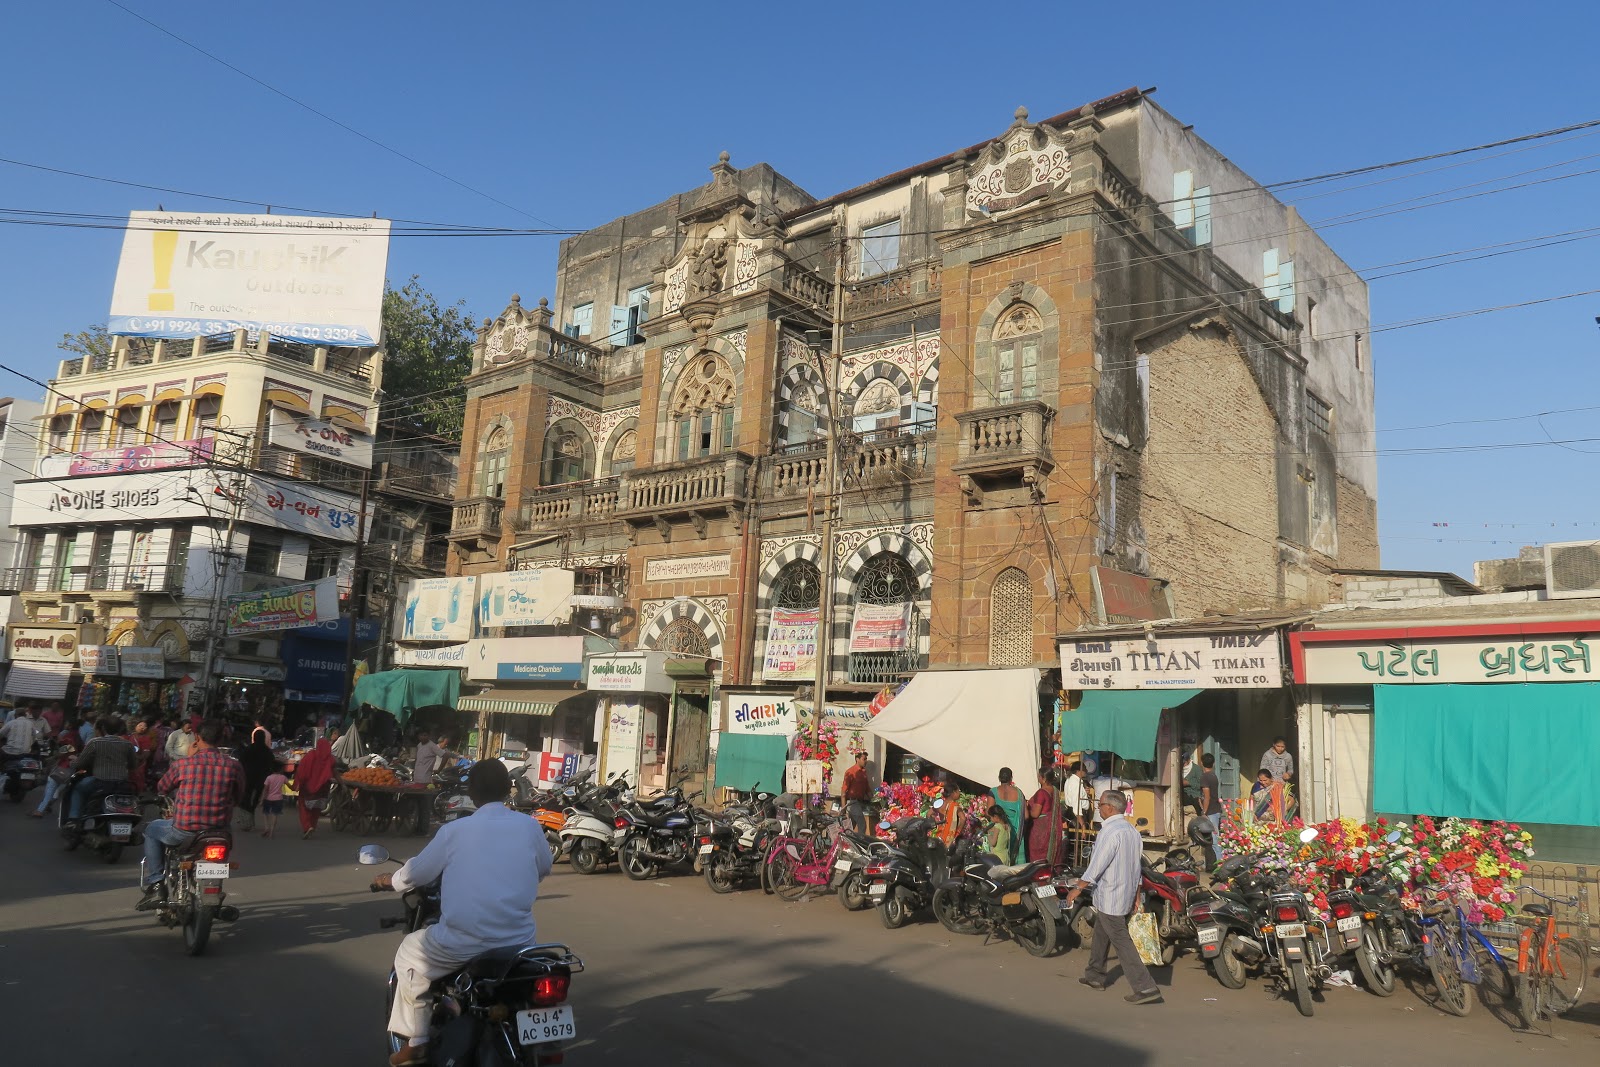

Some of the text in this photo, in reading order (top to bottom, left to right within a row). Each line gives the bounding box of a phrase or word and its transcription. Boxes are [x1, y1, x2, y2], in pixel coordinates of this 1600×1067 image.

[189, 301, 205, 312] The
[305, 440, 342, 457] SHOES
[78, 465, 110, 473] SHOES
[111, 488, 160, 508] SHOES
[1210, 633, 1271, 649] TIMEX
[297, 658, 347, 672] SAMSUNG
[1127, 650, 1201, 672] TITAN
[1212, 657, 1265, 669] TIMANI
[1357, 642, 1439, 677] પટેલ
[513, 664, 563, 673] Medicine Chamber
[1214, 675, 1269, 685] WATCH CO.
[735, 701, 790, 723] સીતારામ
[532, 1012, 560, 1024] GJ 4
[522, 1023, 573, 1041] AC 9679
